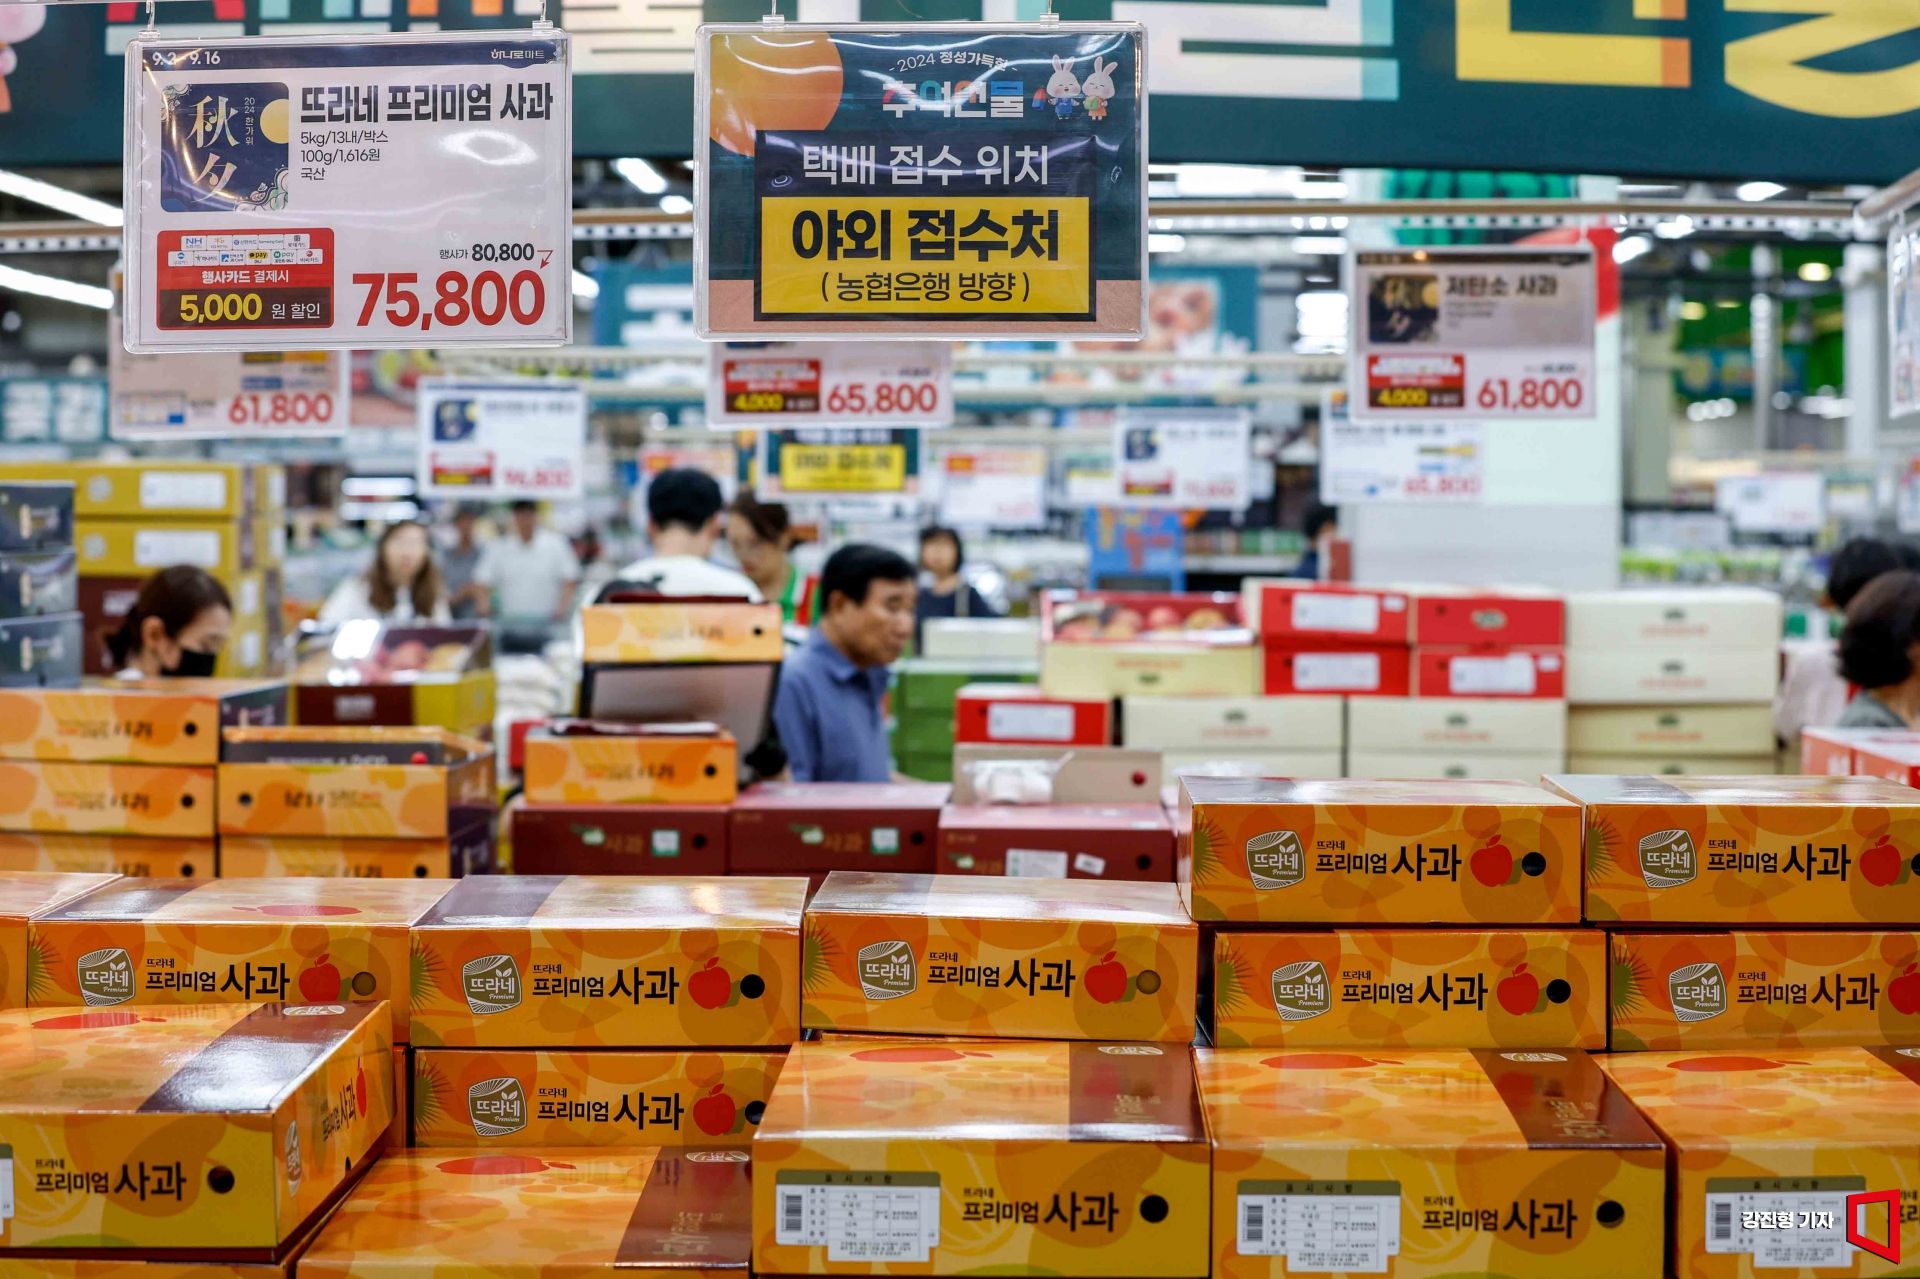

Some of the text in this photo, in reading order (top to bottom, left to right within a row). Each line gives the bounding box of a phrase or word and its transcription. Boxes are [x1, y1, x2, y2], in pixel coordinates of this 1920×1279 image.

[897, 53, 935, 73] 2024
[301, 82, 553, 124] 뜨라네 프리미엄 사과
[301, 149, 380, 165] 100g/1,616원
[802, 145, 1049, 187] 택배 접수 위치
[301, 168, 326, 181] 국산
[792, 208, 1060, 263] 야외 접수처
[440, 243, 535, 262] 행사가 80,800
[202, 269, 289, 284] 행사카드 결제시
[180, 293, 320, 323] 5,000 원 할인
[352, 269, 545, 331] 75,800
[827, 382, 938, 415] 65,800
[1477, 378, 1583, 410] 61,800
[229, 392, 334, 425] 61,800
[1317, 840, 1345, 851] 뜨라네
[1708, 839, 1737, 850] 뜨라네
[1254, 852, 1299, 871] 뜨라네
[1315, 843, 1462, 882] 프리미엄 사과
[1646, 851, 1690, 869] 뜨라네
[1707, 843, 1851, 881] 프리미엄 사과
[146, 958, 175, 969] 뜨라네
[928, 951, 958, 963] 뜨라네
[85, 970, 129, 987] 뜨라네
[533, 964, 562, 975] 뜨라네
[864, 963, 910, 982] 뜨라네
[927, 958, 1076, 997] 프리미엄 사과
[1343, 970, 1371, 981] 뜨라네
[1738, 971, 1766, 982] 뜨라네
[146, 962, 291, 1000] 프리미엄 사과
[470, 976, 515, 994] 뜨라네
[532, 966, 680, 1005] 프리미엄 사과
[1279, 982, 1325, 1001] 뜨라네
[1341, 972, 1488, 1012] 프리미엄 사과
[1676, 984, 1720, 1002] 뜨라네
[1737, 973, 1880, 1011] 프리미엄 사과
[538, 1087, 567, 1098] 뜨라네
[476, 1099, 520, 1117] 뜨라네
[537, 1092, 685, 1130] 프리미엄 사과
[35, 1160, 187, 1201] 프리미엄 사과
[962, 1201, 1039, 1224] 프리미엄
[1043, 1191, 1119, 1233] 사과
[1422, 1209, 1498, 1233] 프리미엄
[1503, 1199, 1578, 1240] 사과
